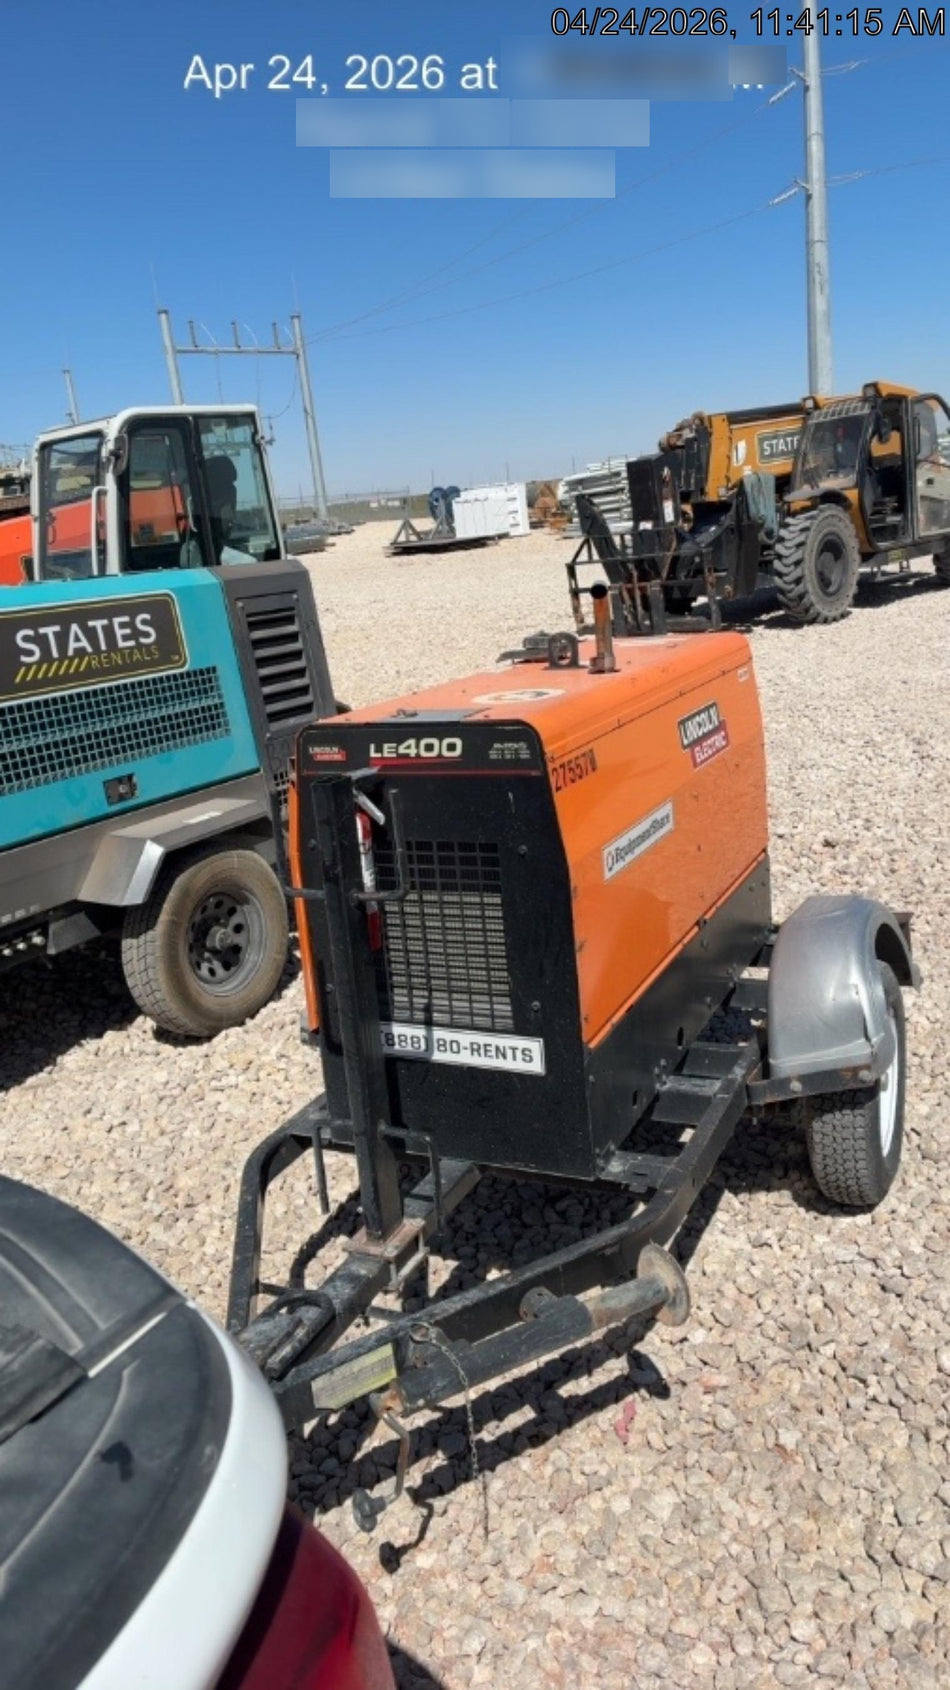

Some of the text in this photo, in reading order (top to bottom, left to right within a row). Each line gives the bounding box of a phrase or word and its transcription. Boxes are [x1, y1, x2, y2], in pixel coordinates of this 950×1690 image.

[15, 613, 157, 663] STATES
[90, 645, 160, 671] RENTALS
[680, 705, 719, 746] LINCOLN
[693, 730, 727, 763] ELECTRIC
[437, 1038, 533, 1063] 80-RENTS
